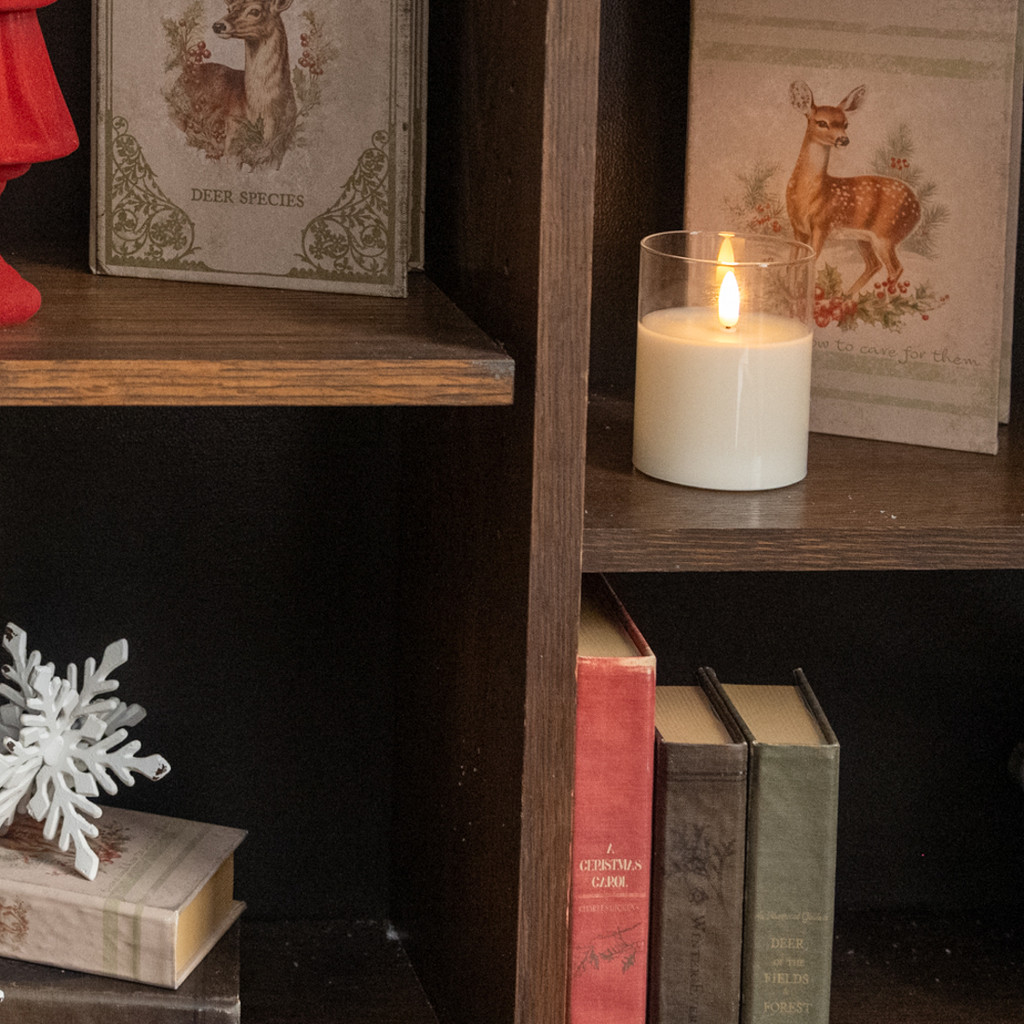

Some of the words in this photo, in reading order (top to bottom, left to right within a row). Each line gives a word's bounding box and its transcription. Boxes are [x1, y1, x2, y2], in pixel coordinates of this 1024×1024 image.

[191, 188, 234, 204] DEER
[239, 191, 305, 208] SPECIES
[812, 339, 830, 349] ow
[835, 339, 854, 352] to
[860, 346, 897, 358] care
[898, 346, 927, 364] for
[933, 349, 980, 366] them
[606, 842, 615, 854] A
[579, 858, 643, 872] CHRISTMAS
[591, 875, 629, 889] CAROL
[771, 937, 804, 950] DEER
[764, 972, 810, 985] FIELDS
[763, 1001, 813, 1015] FOREST
